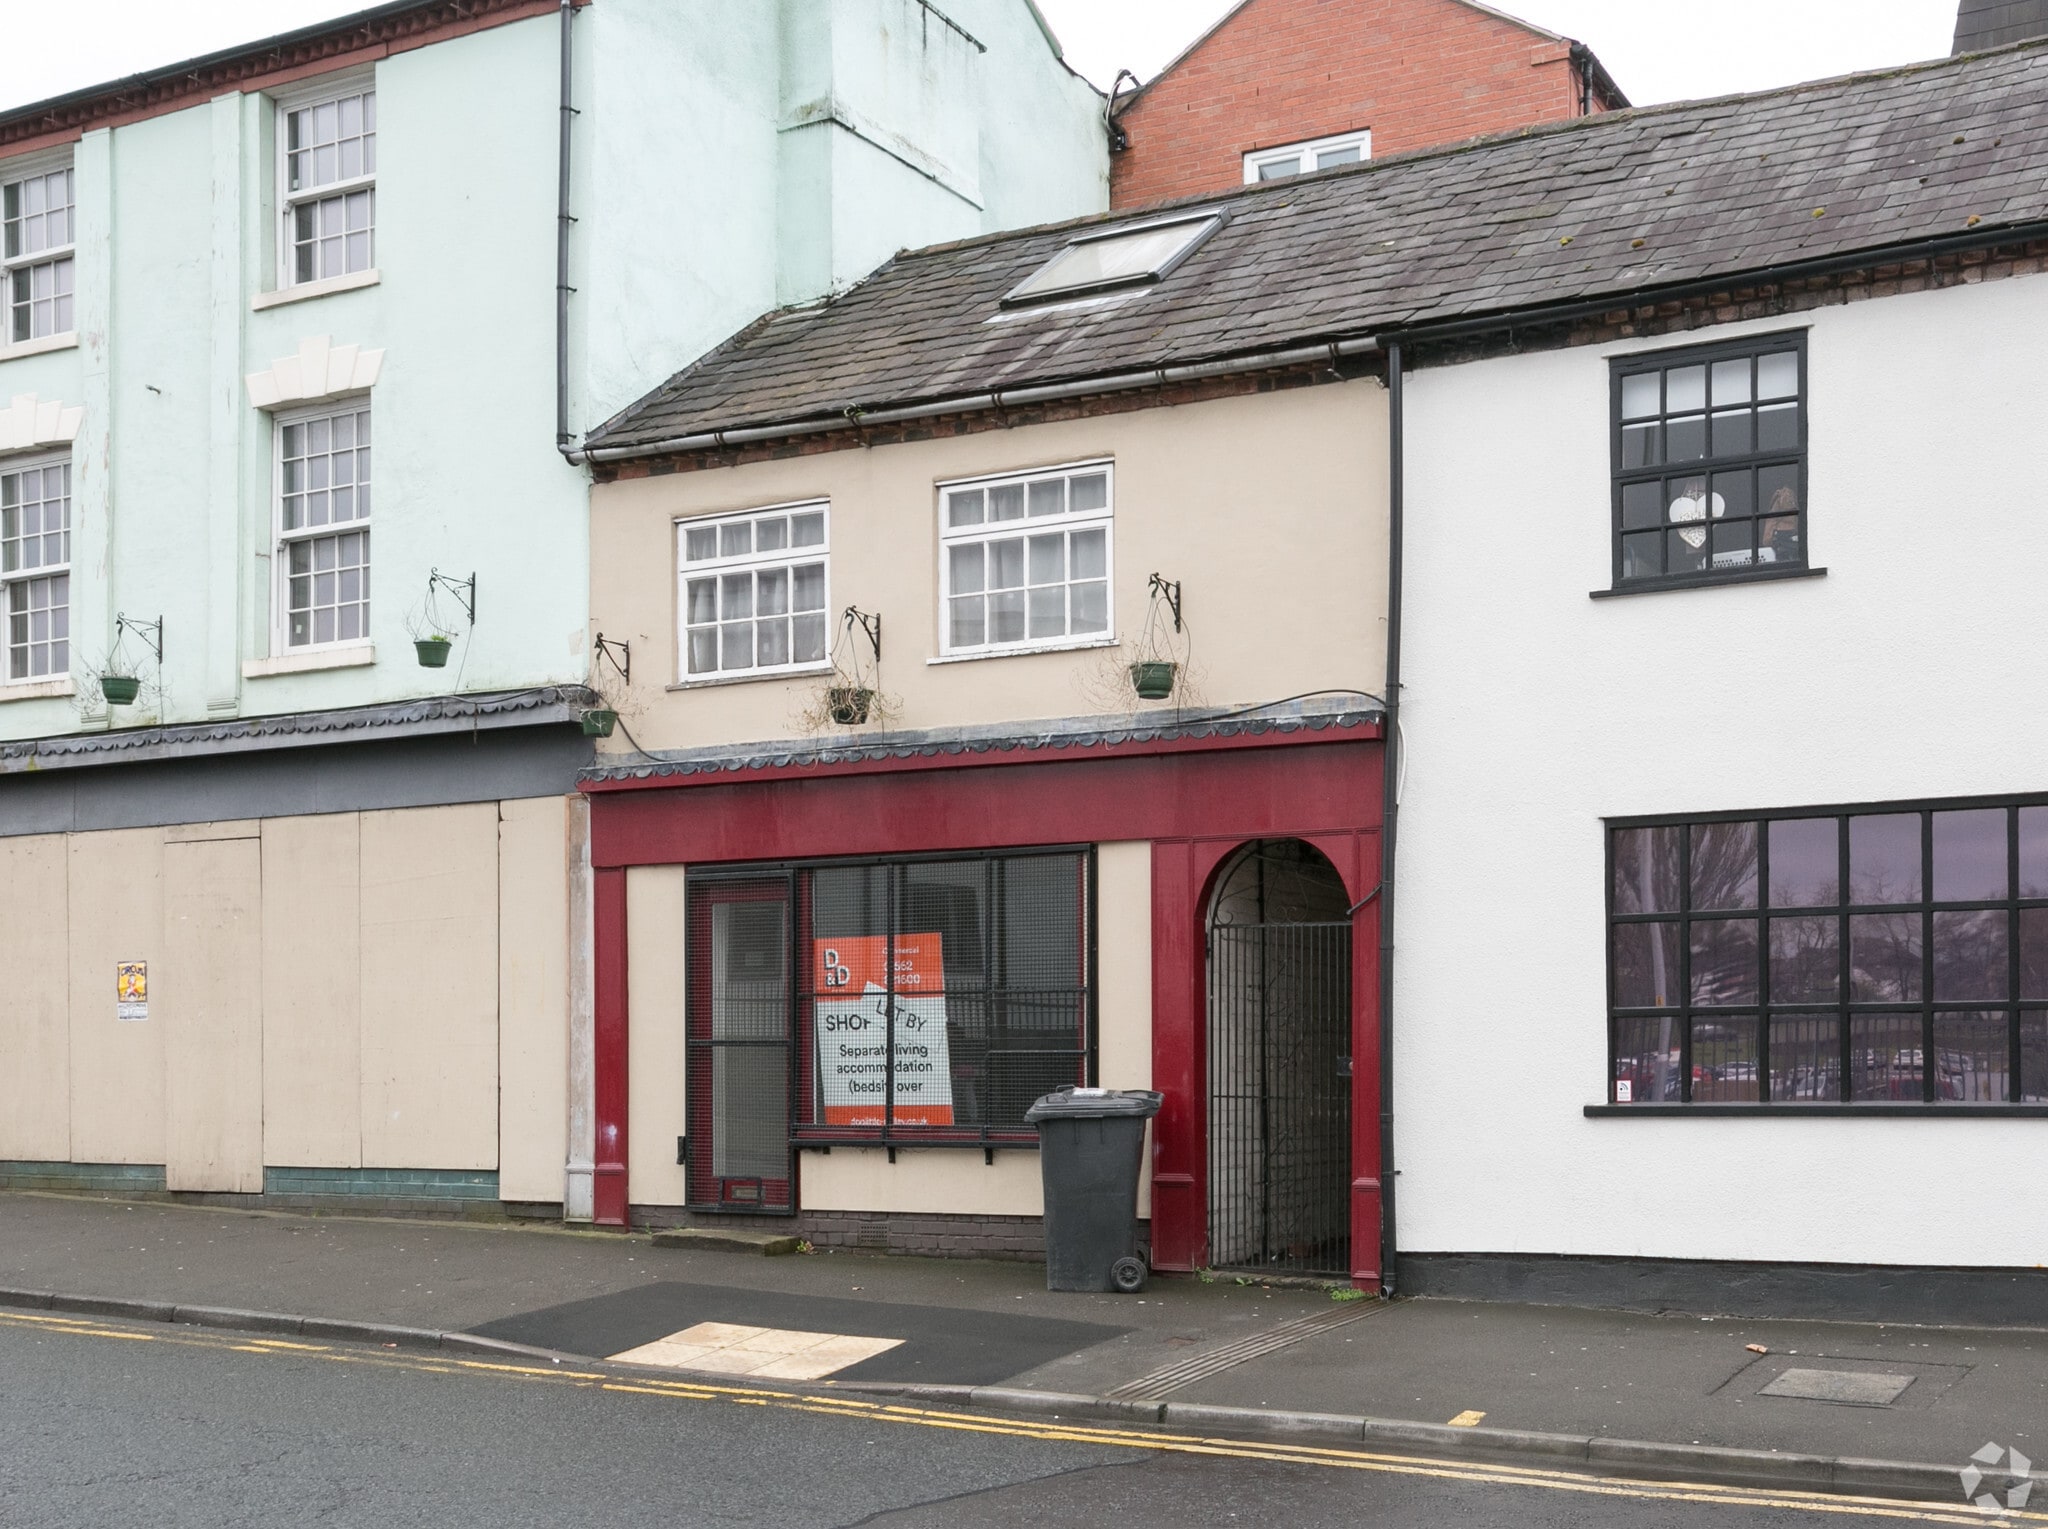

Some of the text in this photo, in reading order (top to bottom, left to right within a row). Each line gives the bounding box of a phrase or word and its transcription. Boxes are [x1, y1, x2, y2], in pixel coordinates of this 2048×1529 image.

[875, 998, 928, 1032] LT BY
[839, 1042, 928, 1059] Separat living
[836, 1059, 933, 1074] accommdation
[849, 1078, 923, 1095] (bedsi over
